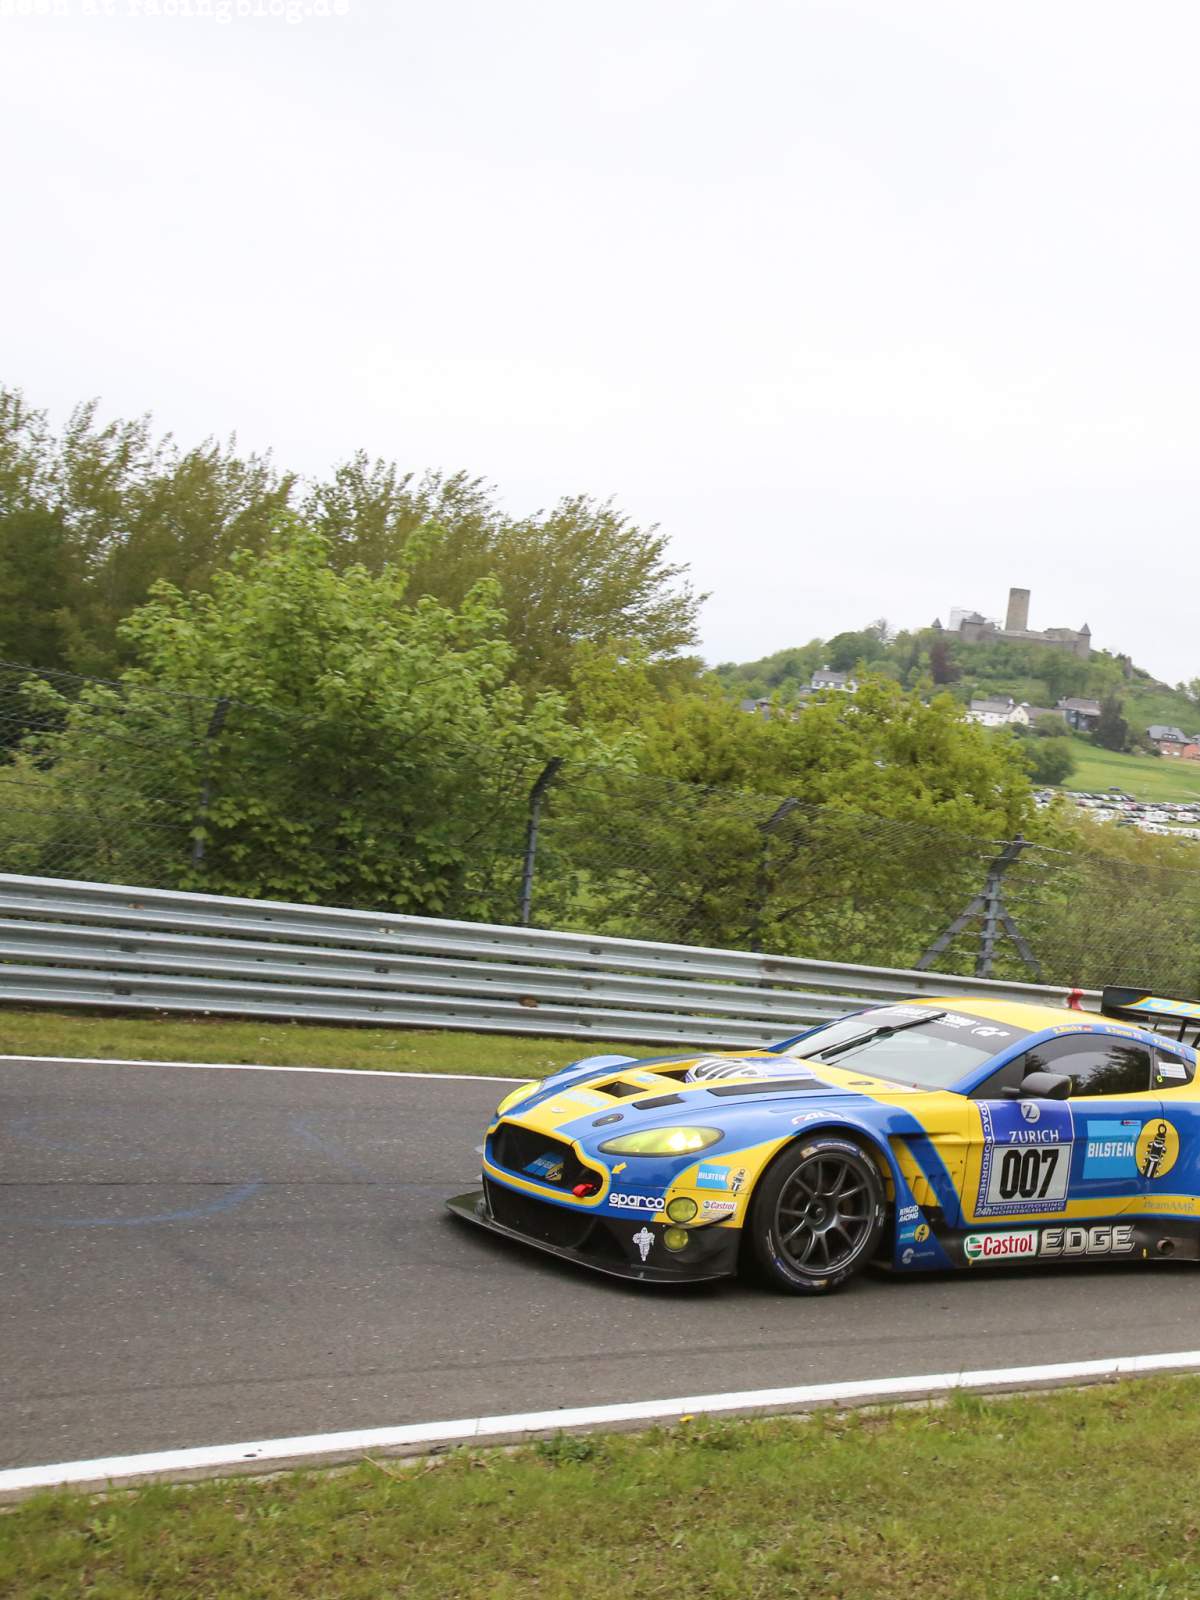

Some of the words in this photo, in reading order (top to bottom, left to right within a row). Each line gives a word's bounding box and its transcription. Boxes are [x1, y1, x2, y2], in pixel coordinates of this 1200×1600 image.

[1009, 1129, 1060, 1144] ZURICH
[1088, 1142, 1135, 1158] BILSTEIN
[1000, 1149, 1059, 1200] 007
[609, 1193, 665, 1208] sparco
[710, 1202, 735, 1210] Castrol
[984, 1235, 1033, 1256] Castrol
[1039, 1225, 1136, 1257] EDGE
